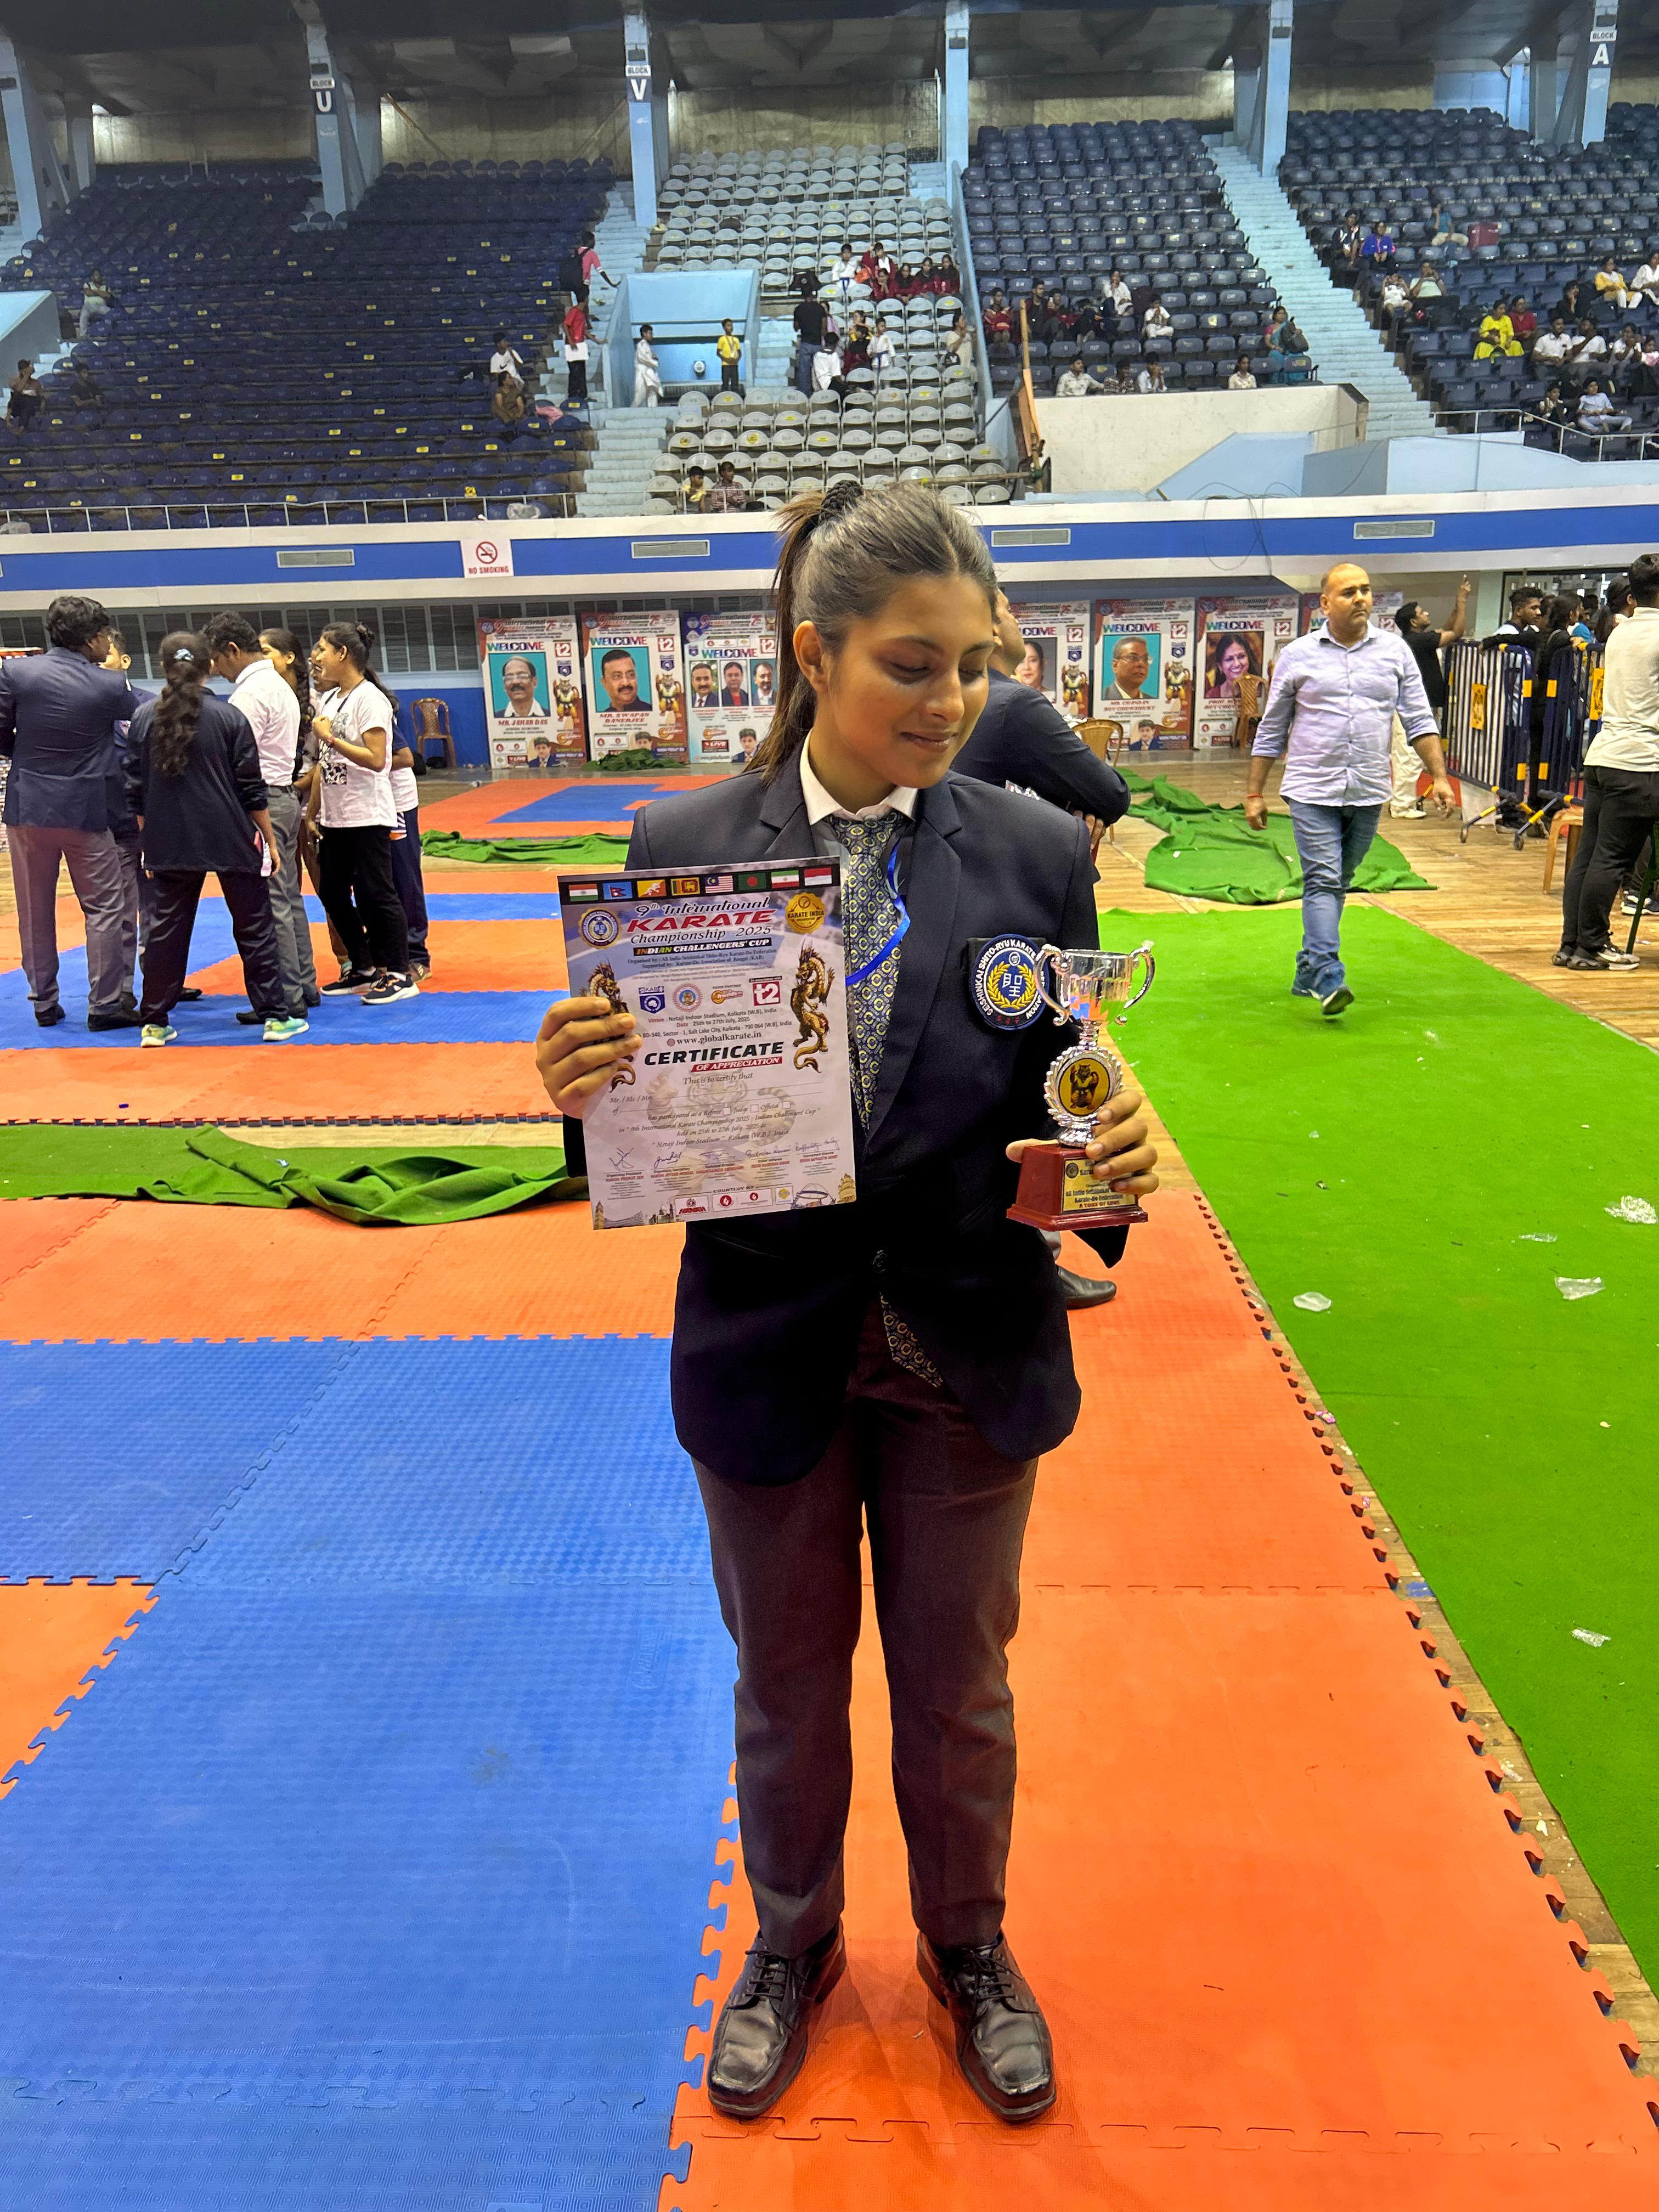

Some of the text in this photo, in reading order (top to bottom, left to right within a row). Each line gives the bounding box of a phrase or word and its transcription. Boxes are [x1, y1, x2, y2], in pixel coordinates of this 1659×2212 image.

[1592, 43, 1609, 65] A
[631, 79, 647, 100] V
[316, 91, 332, 112] U
[479, 566, 509, 574] SMOKING
[1103, 623, 1161, 633] WELCOME
[1206, 620, 1265, 630] WELCOME
[487, 641, 544, 651] WELCOME
[590, 636, 647, 645] WELCOME
[702, 648, 758, 658] WELCOME
[636, 896, 769, 916] 9th International
[627, 910, 777, 932] KARATE
[631, 926, 773, 944] Championship 2025
[636, 946, 672, 955] INDIAN
[673, 940, 748, 952] CHALLENGERS'
[979, 939, 1010, 970] SHITO-RYU
[1010, 939, 1036, 960] KARATE
[754, 983, 779, 1005] t2
[975, 969, 994, 1016] SEISHINKAI
[676, 1031, 762, 1045] www.globalkarate.in
[645, 1041, 785, 1065] CERTIFICATE
[710, 1057, 780, 1070] APPRECIATION
[715, 1074, 737, 1084] certify
[612, 1107, 620, 1116] of
[641, 1121, 678, 1131] International
[697, 1118, 735, 1127] Championship
[657, 1141, 675, 1149] Netaji
